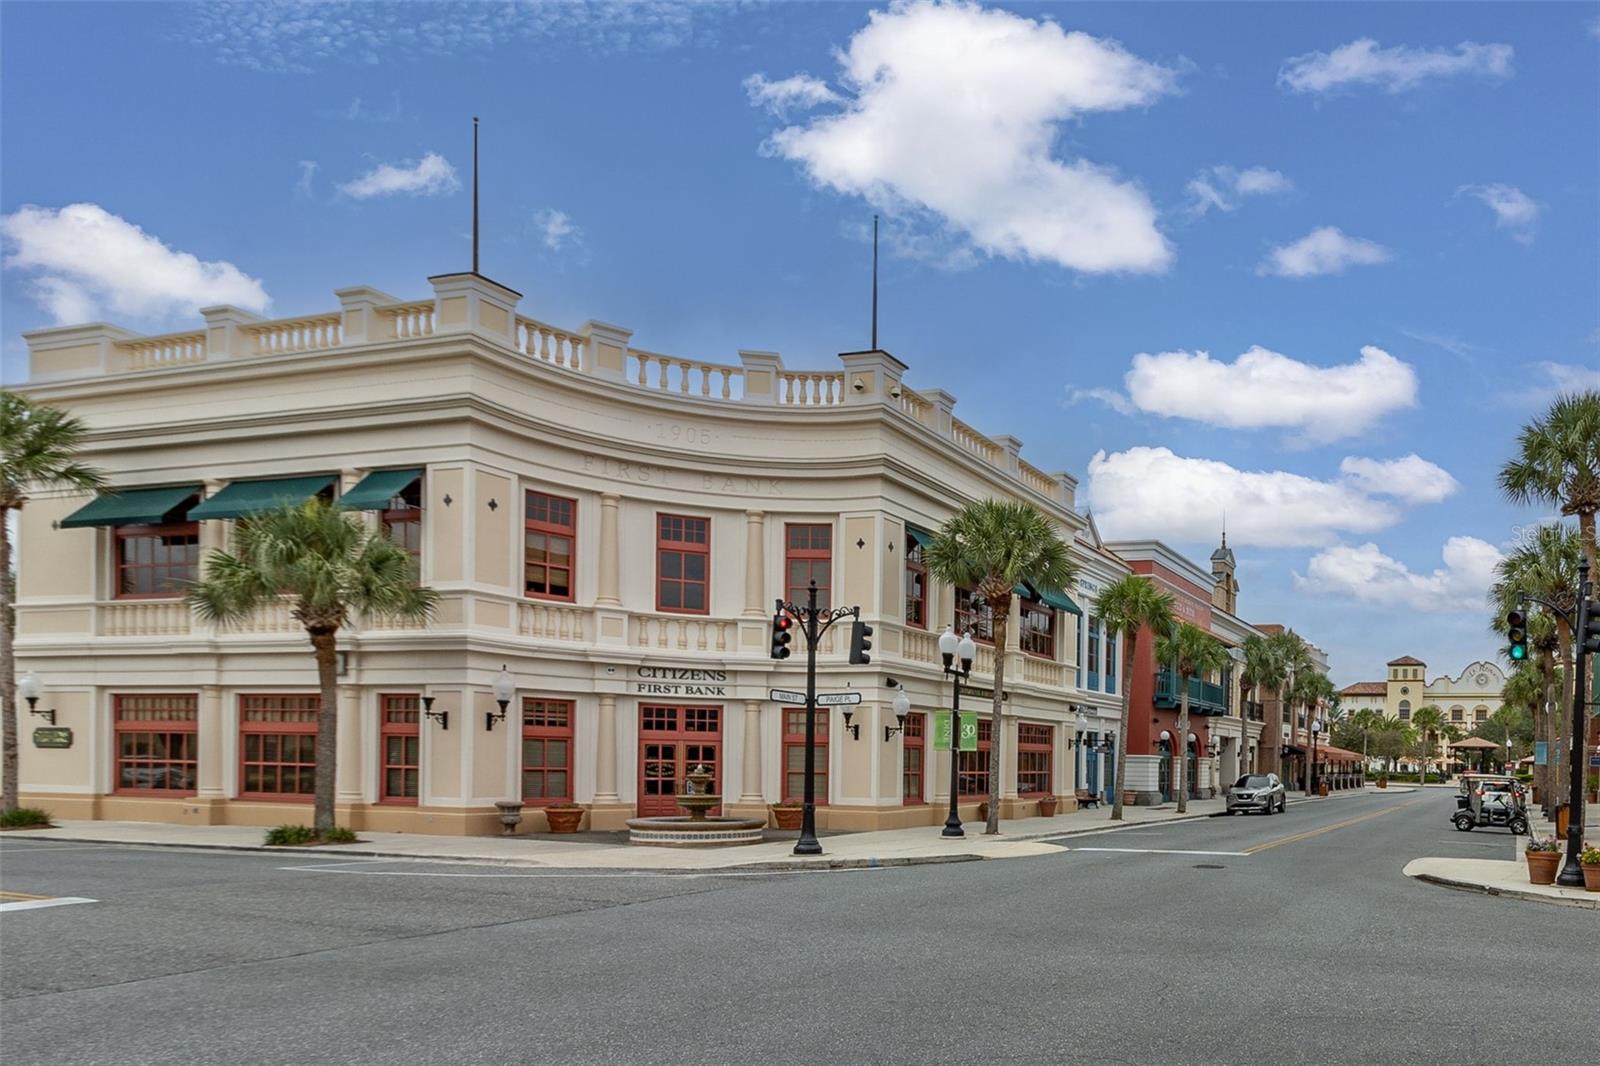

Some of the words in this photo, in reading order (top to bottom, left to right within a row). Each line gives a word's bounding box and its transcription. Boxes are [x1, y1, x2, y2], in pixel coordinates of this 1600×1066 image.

[582, 455, 672, 485] FIRST
[702, 475, 783, 495] BANK
[637, 666, 727, 681] CITIZENS
[637, 683, 681, 694] FIRST
[685, 685, 726, 696] BANK
